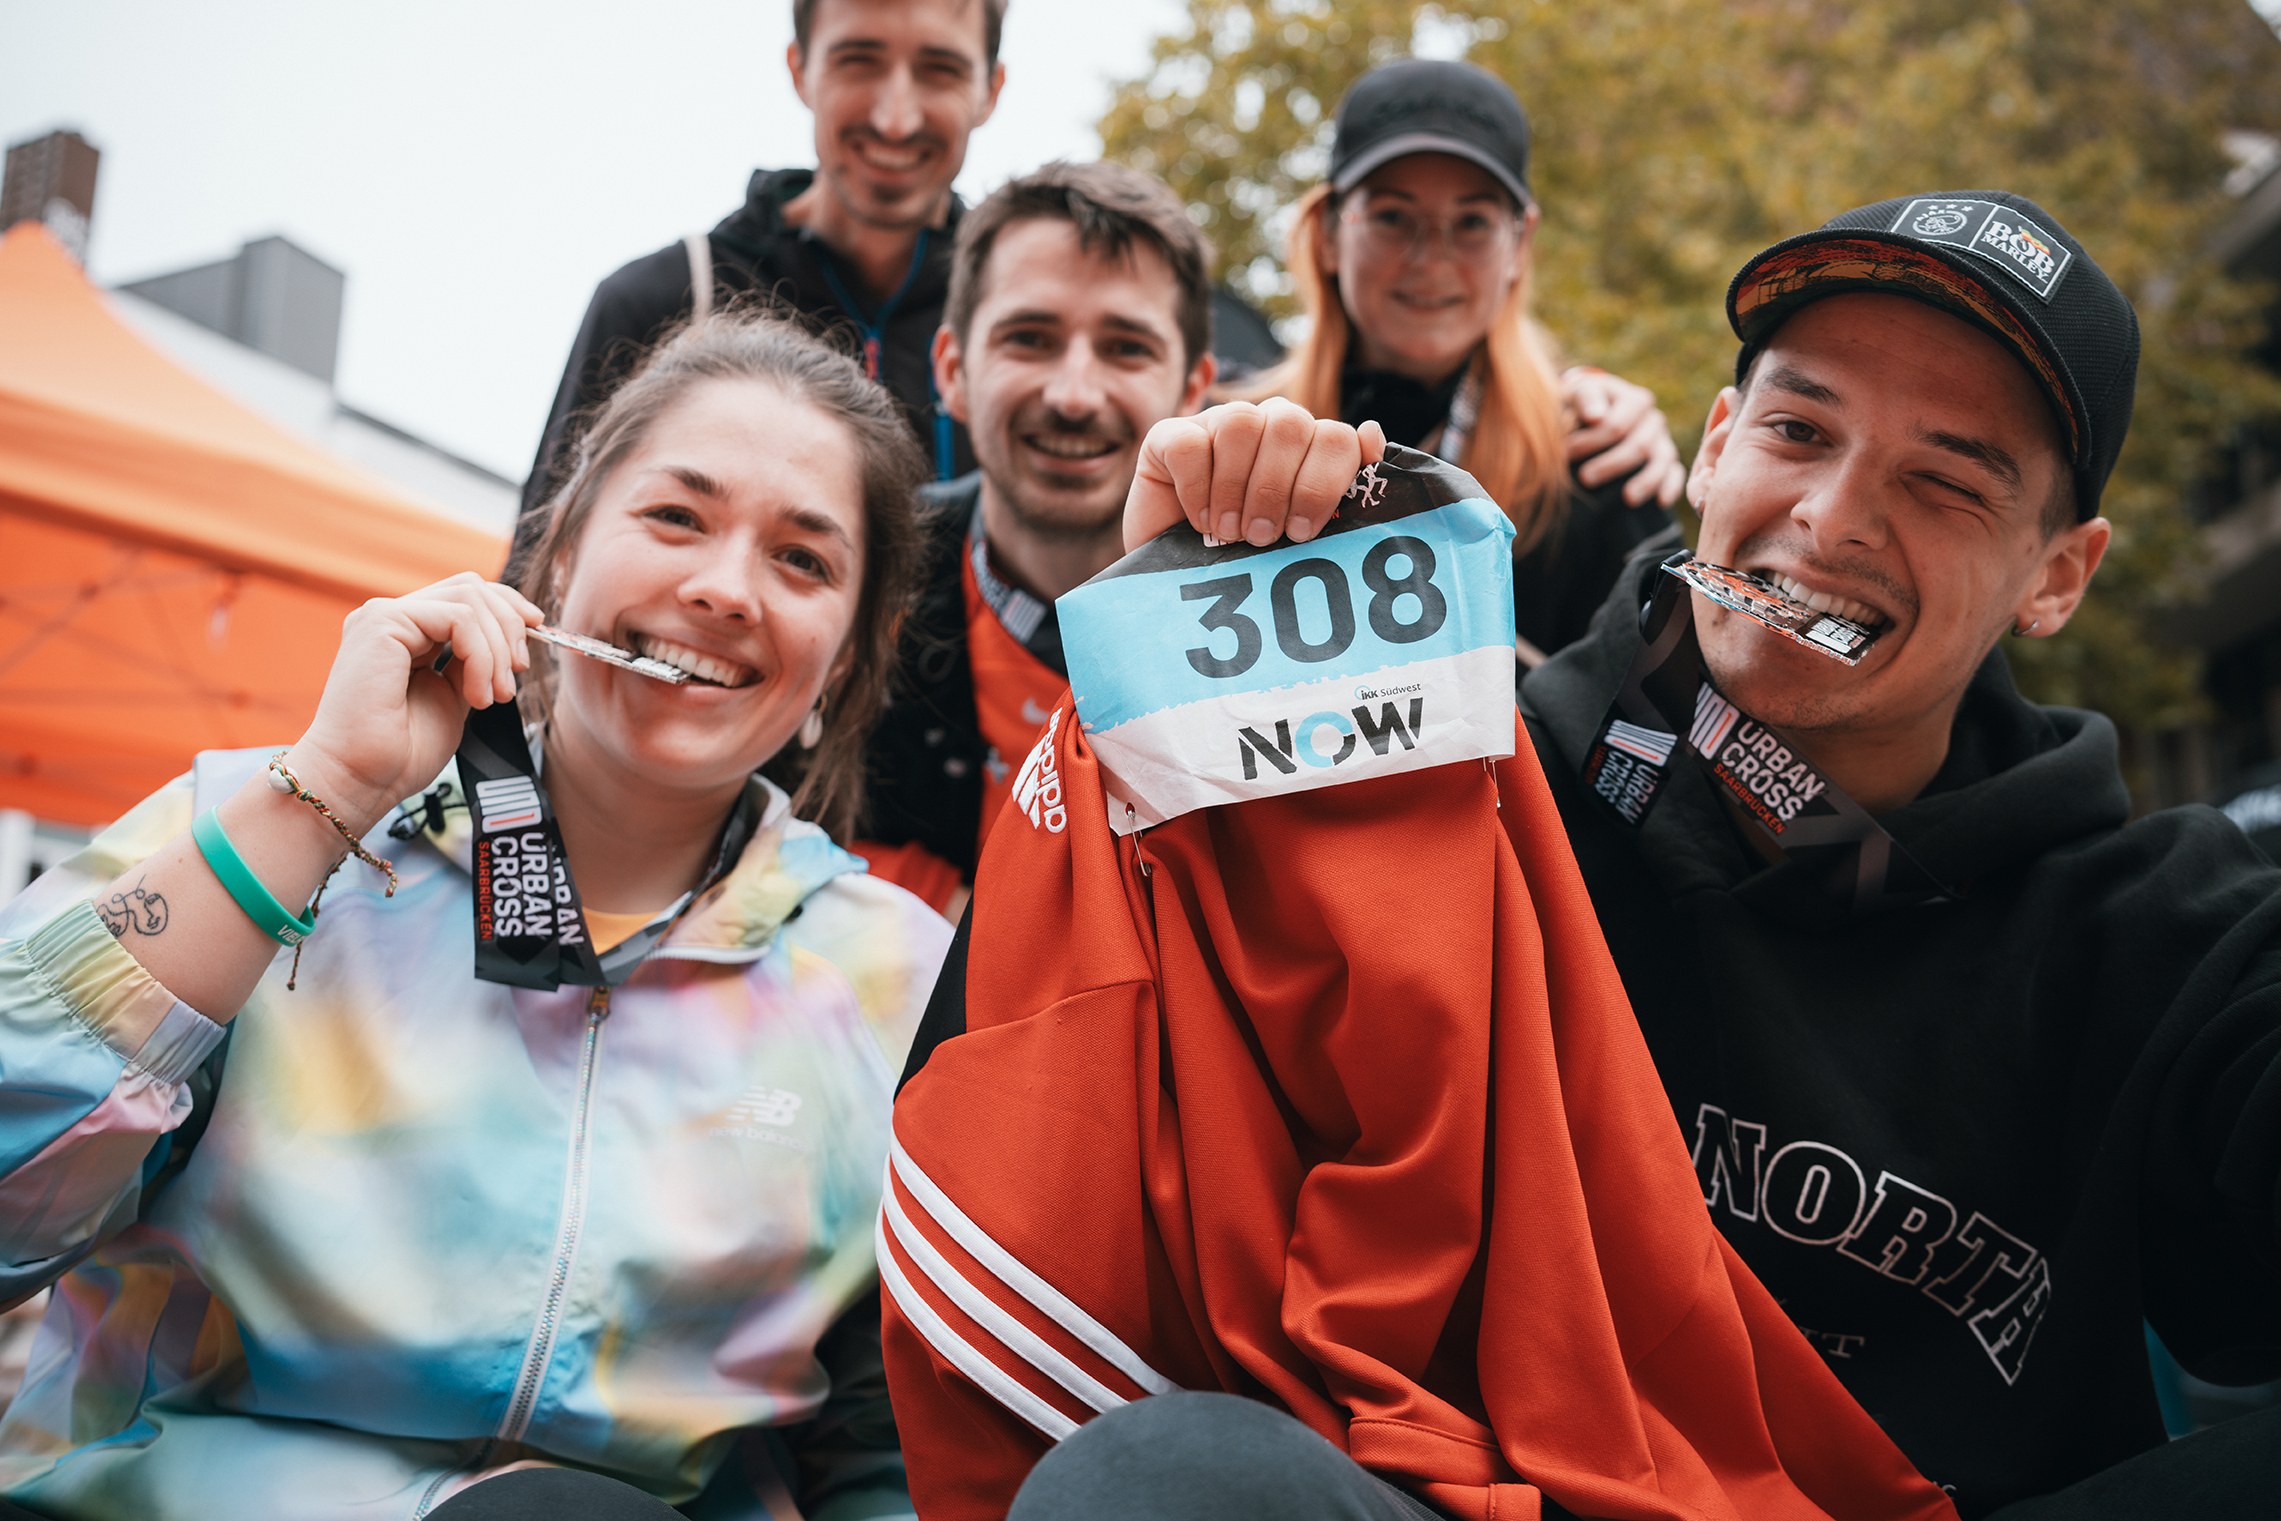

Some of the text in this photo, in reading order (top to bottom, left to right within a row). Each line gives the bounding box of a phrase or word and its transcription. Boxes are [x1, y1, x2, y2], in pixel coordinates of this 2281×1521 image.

[1980, 233, 2050, 284] MARLEY
[1985, 221, 2055, 273] BOB
[1179, 535, 1447, 679] 308
[1380, 683, 1422, 697] Südwest
[1036, 706, 1068, 834] adidas
[1237, 697, 1424, 780] NOW
[1594, 750, 1634, 804] CROSS
[1737, 719, 1826, 802] URBAN
[1615, 763, 1661, 825] URBAN
[1713, 762, 1787, 834] SAARBRÜCKEN
[1721, 741, 1804, 821] CROSS
[478, 841, 494, 940] SAARBRÜCKEN
[491, 835, 524, 937] CROSS
[520, 831, 553, 936] URBAN
[1693, 1102, 2052, 1387] NORTA
